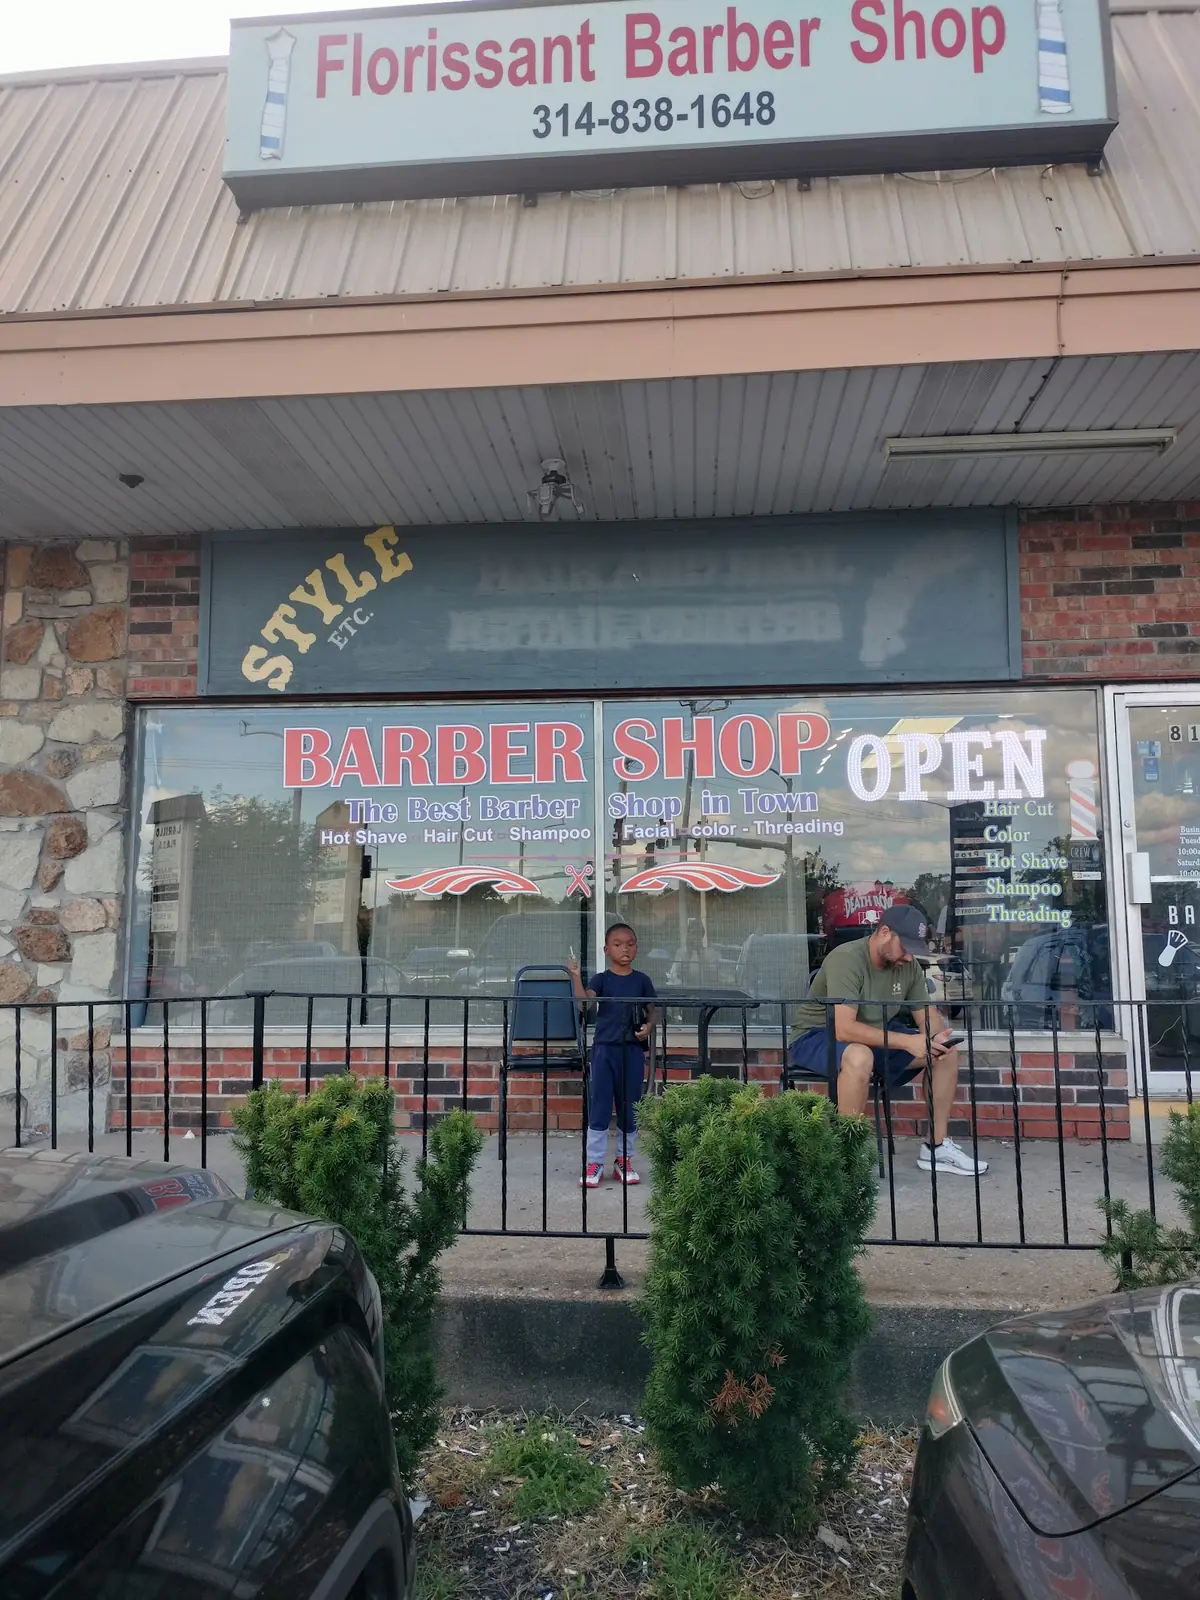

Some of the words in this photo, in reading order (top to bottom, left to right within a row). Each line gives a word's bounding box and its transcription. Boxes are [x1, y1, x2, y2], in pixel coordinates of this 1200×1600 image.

[315, 17, 596, 99] Florissant
[625, 5, 820, 80] Barber
[850, 0, 1006, 73] Shop
[532, 91, 776, 139] 314-838-1648
[241, 525, 413, 692] STYLE
[327, 608, 375, 651] ETC.
[283, 721, 588, 789] BARBER
[612, 711, 831, 781] SHOP
[846, 728, 1048, 802] OPEN
[345, 797, 399, 824] The
[407, 795, 471, 823] Best
[479, 794, 580, 822] Barber
[608, 791, 682, 822] Shop
[701, 790, 730, 815] in
[737, 787, 818, 814] Town
[983, 801, 1020, 816] Hair
[1024, 801, 1054, 816] Cut
[320, 829, 350, 845] Hot
[355, 828, 407, 845] Shave
[423, 828, 458, 844] Hair
[463, 827, 494, 843] Cut
[509, 825, 591, 846] Shampoo
[623, 822, 675, 839] Facial
[691, 821, 737, 837] color
[753, 819, 845, 837] Threading
[983, 824, 1031, 843] Color
[985, 852, 1017, 869] Hot
[1021, 851, 1068, 869] Shave
[986, 876, 1062, 900] Shampoo
[844, 895, 871, 919] DEATH
[873, 895, 894, 910] ROW
[987, 903, 1073, 929] Threading
